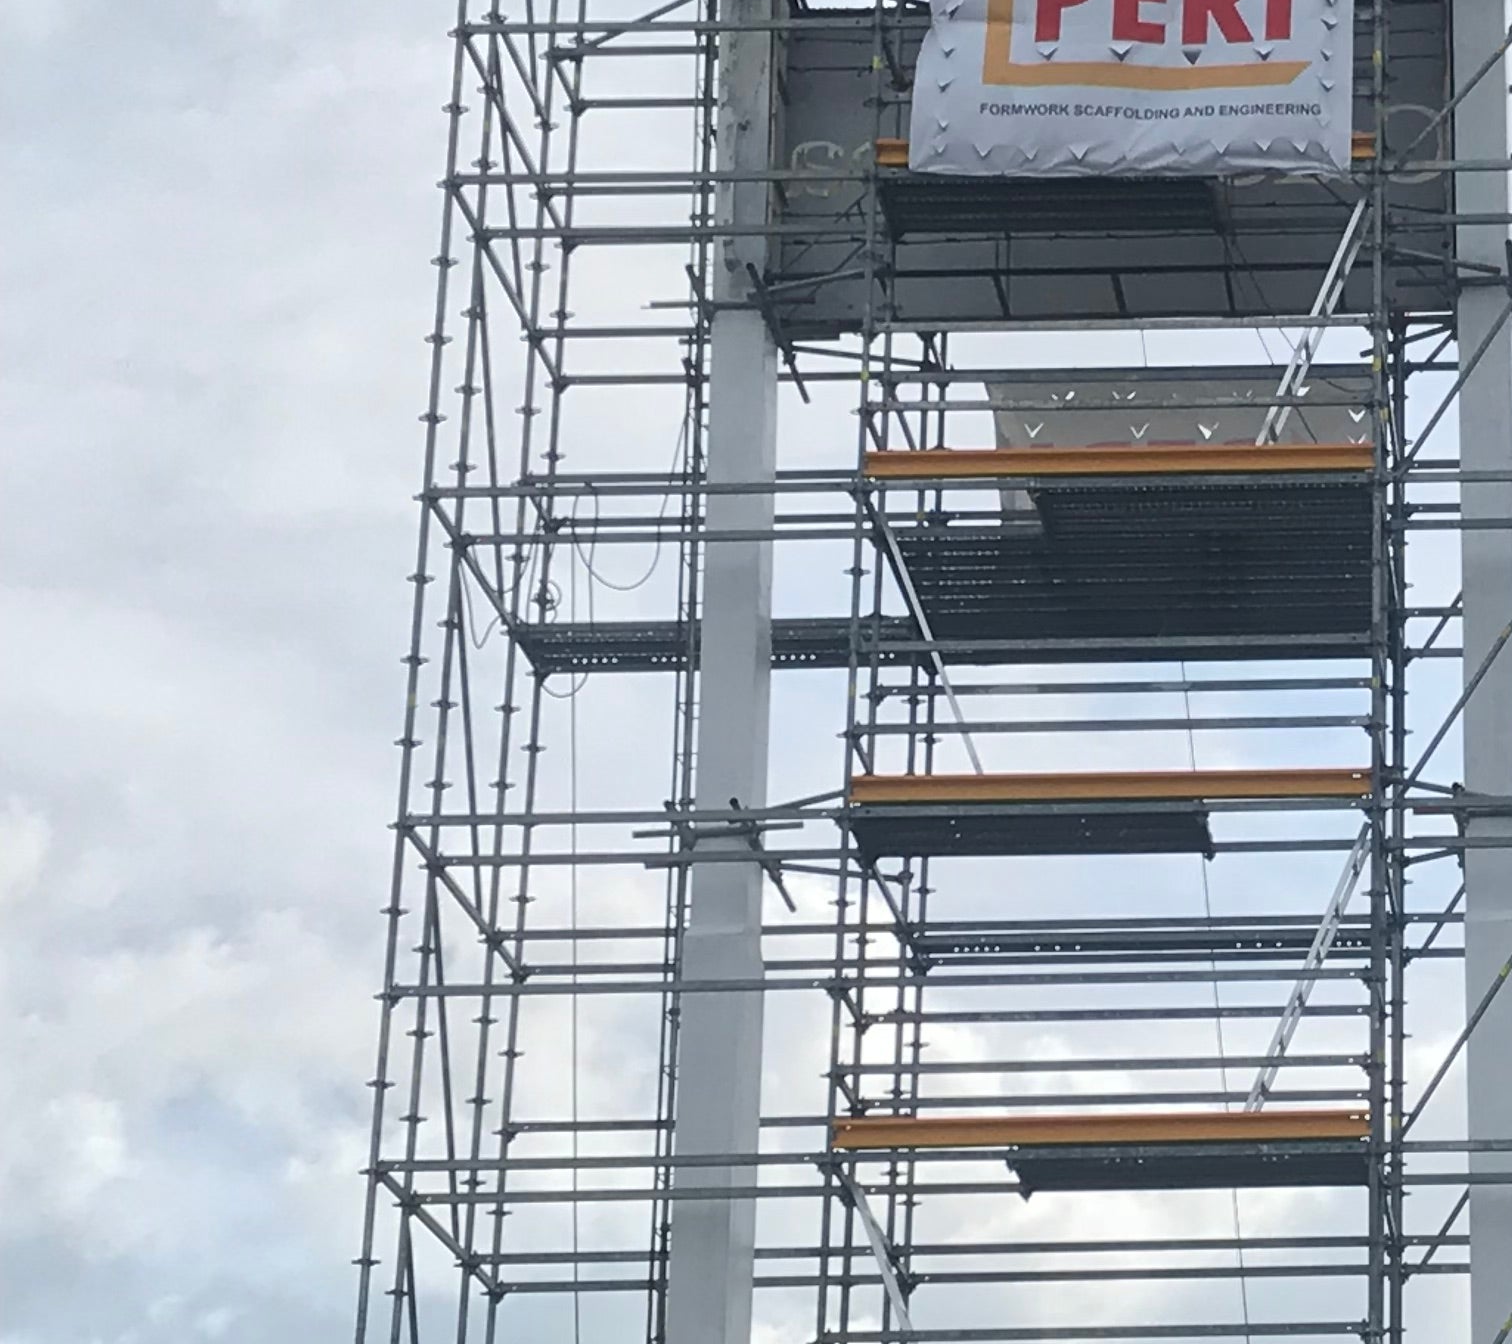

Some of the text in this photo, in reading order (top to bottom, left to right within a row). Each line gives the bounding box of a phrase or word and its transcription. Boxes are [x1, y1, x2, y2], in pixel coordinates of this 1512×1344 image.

[980, 103, 1322, 120] FORMWORK SCAFFOLDING AND ENGINEERING
